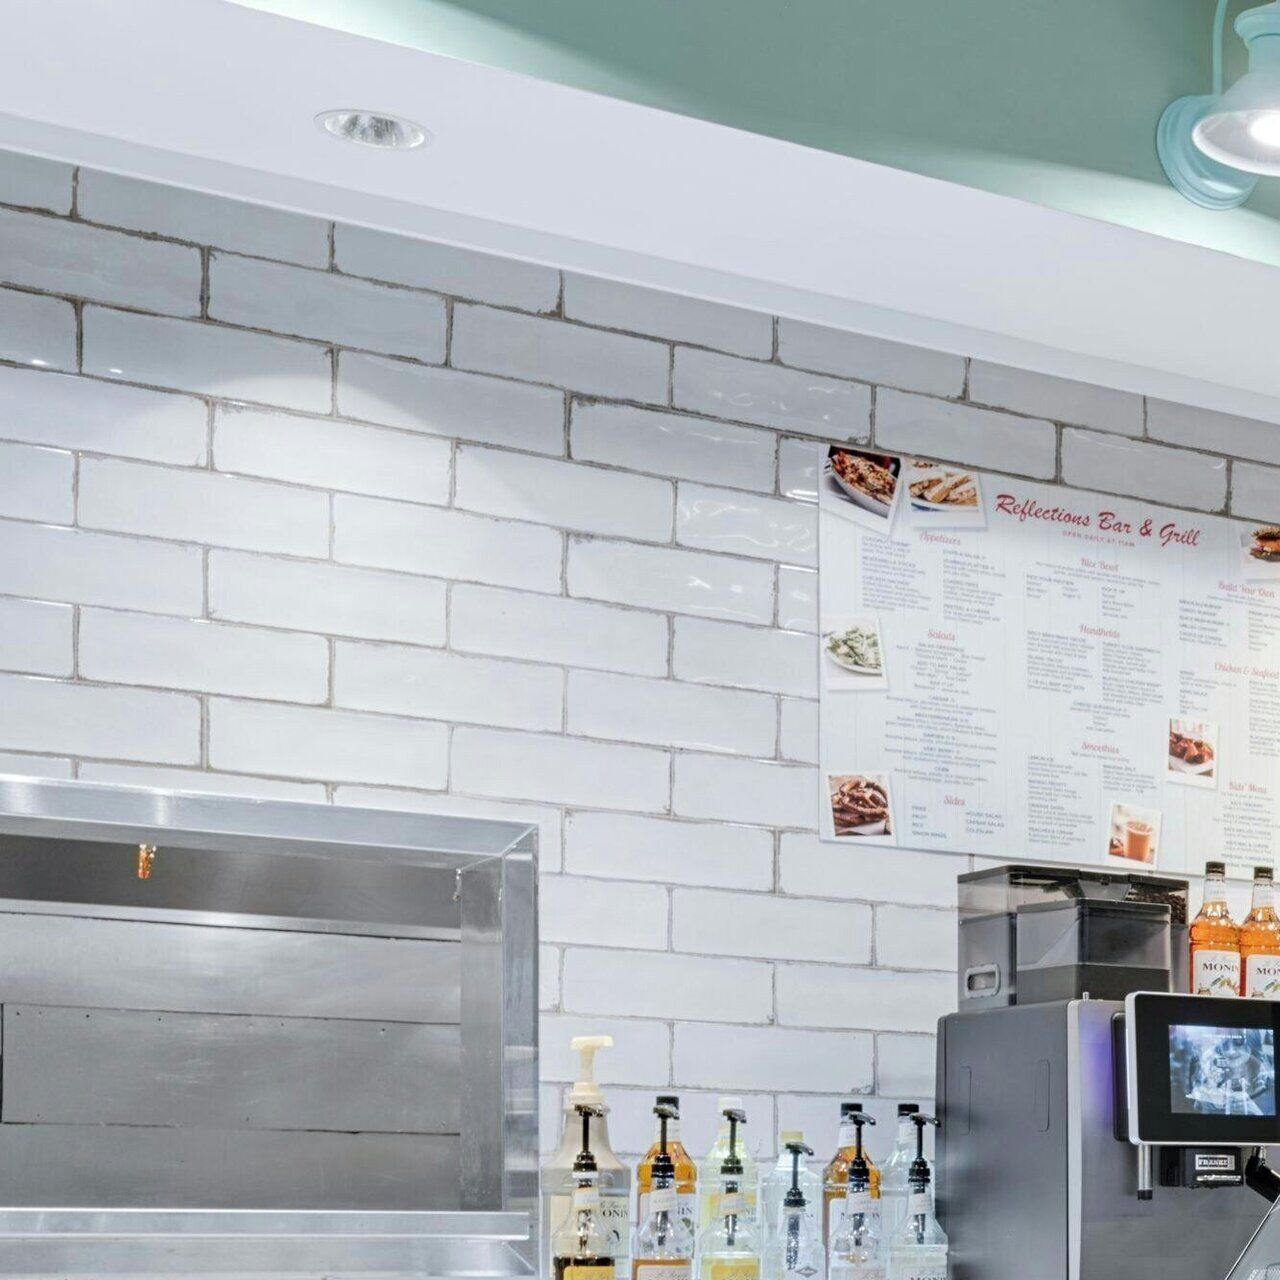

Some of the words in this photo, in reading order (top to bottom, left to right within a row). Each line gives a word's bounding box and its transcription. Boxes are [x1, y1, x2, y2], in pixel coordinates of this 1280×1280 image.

[996, 494, 1091, 527] Reflections
[1098, 512, 1132, 535] Bar
[1139, 519, 1152, 537] &
[1159, 524, 1201, 547] Grill
[927, 629, 955, 642] Salads
[944, 795, 965, 806] Sides
